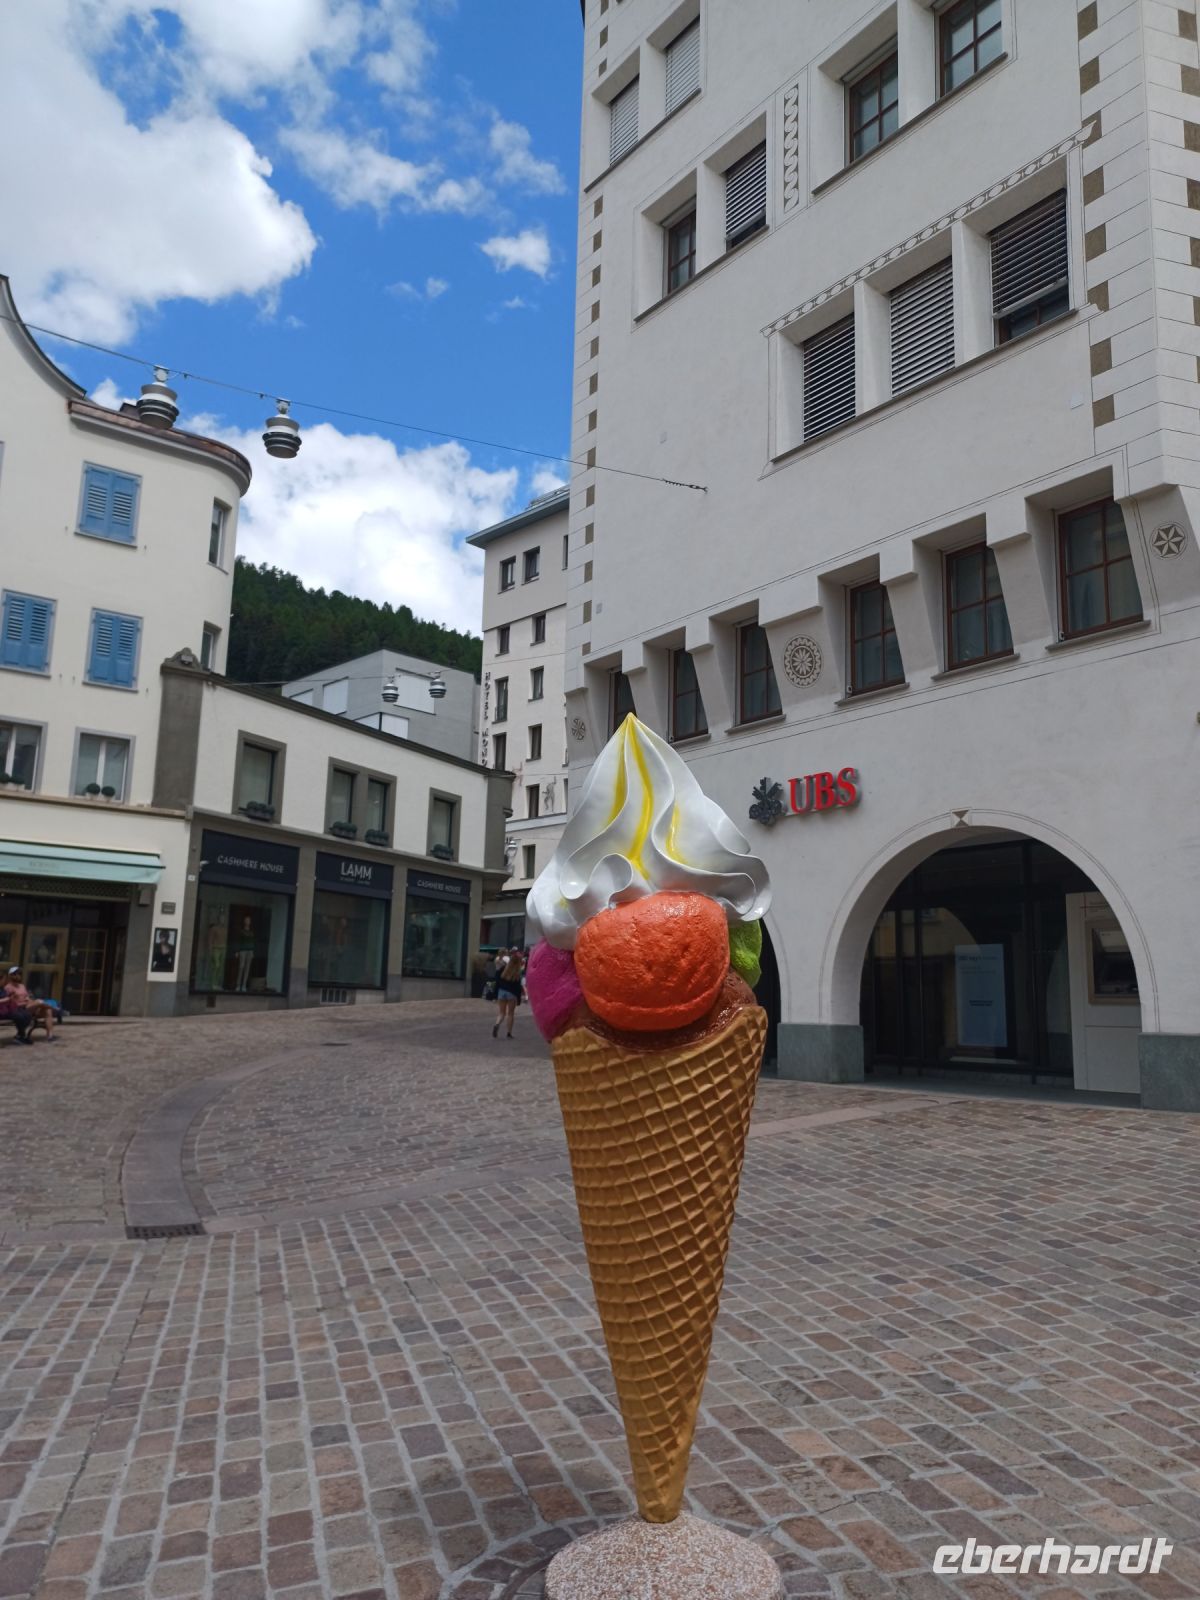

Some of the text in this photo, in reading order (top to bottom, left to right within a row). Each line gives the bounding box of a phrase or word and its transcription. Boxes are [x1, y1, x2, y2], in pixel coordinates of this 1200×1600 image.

[788, 767, 860, 814] UBS
[217, 855, 284, 874] CASHMERE HOUSE
[340, 862, 372, 880] LAMM
[416, 879, 462, 894] CASHMERE HOUSE
